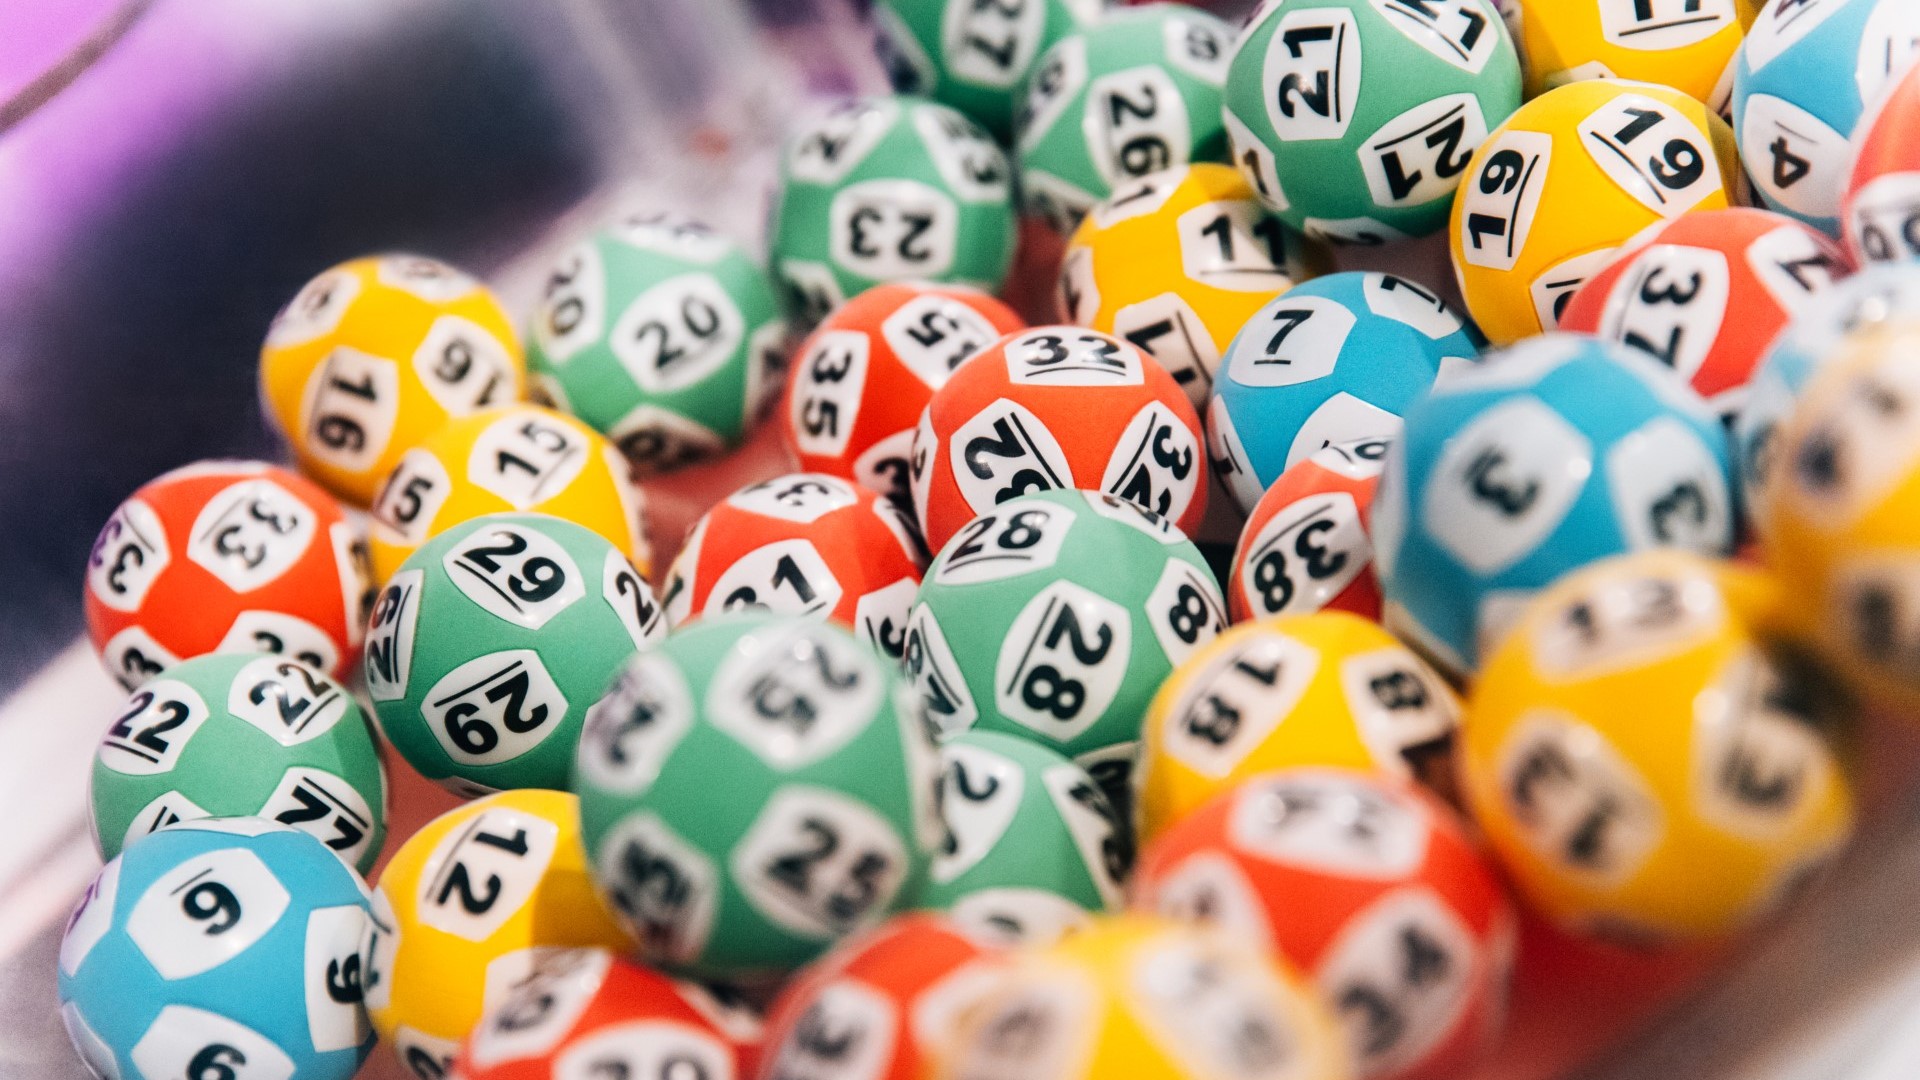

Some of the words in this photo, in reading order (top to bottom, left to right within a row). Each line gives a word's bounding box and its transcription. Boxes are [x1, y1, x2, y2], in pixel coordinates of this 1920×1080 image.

[1279, 26, 1334, 118] 21
[1109, 84, 1170, 177] 26
[1380, 116, 1474, 200] 21
[1613, 106, 1704, 190] 19
[1769, 136, 1811, 189] 4
[849, 206, 934, 263] 23
[1468, 149, 1524, 249] 19
[1202, 214, 1286, 267] 11
[634, 297, 720, 369] 20
[1022, 334, 1126, 369] 32
[1273, 309, 1315, 355] 7
[1624, 267, 1701, 368] 37
[317, 375, 377, 453] 16
[803, 350, 852, 438] 35
[496, 422, 567, 477] 15
[1466, 446, 1538, 519] 3
[93, 519, 144, 594] 33
[214, 500, 299, 570] 33
[461, 530, 567, 603] 29
[948, 510, 1051, 564] 28
[1255, 519, 1347, 613] 38
[615, 560, 655, 628] 2
[1170, 583, 1222, 644] 8
[366, 585, 402, 685] 29
[1022, 603, 1113, 721] 28
[107, 691, 190, 754] 22
[248, 663, 332, 726] 22
[444, 669, 549, 755] 29
[436, 828, 529, 915] 12
